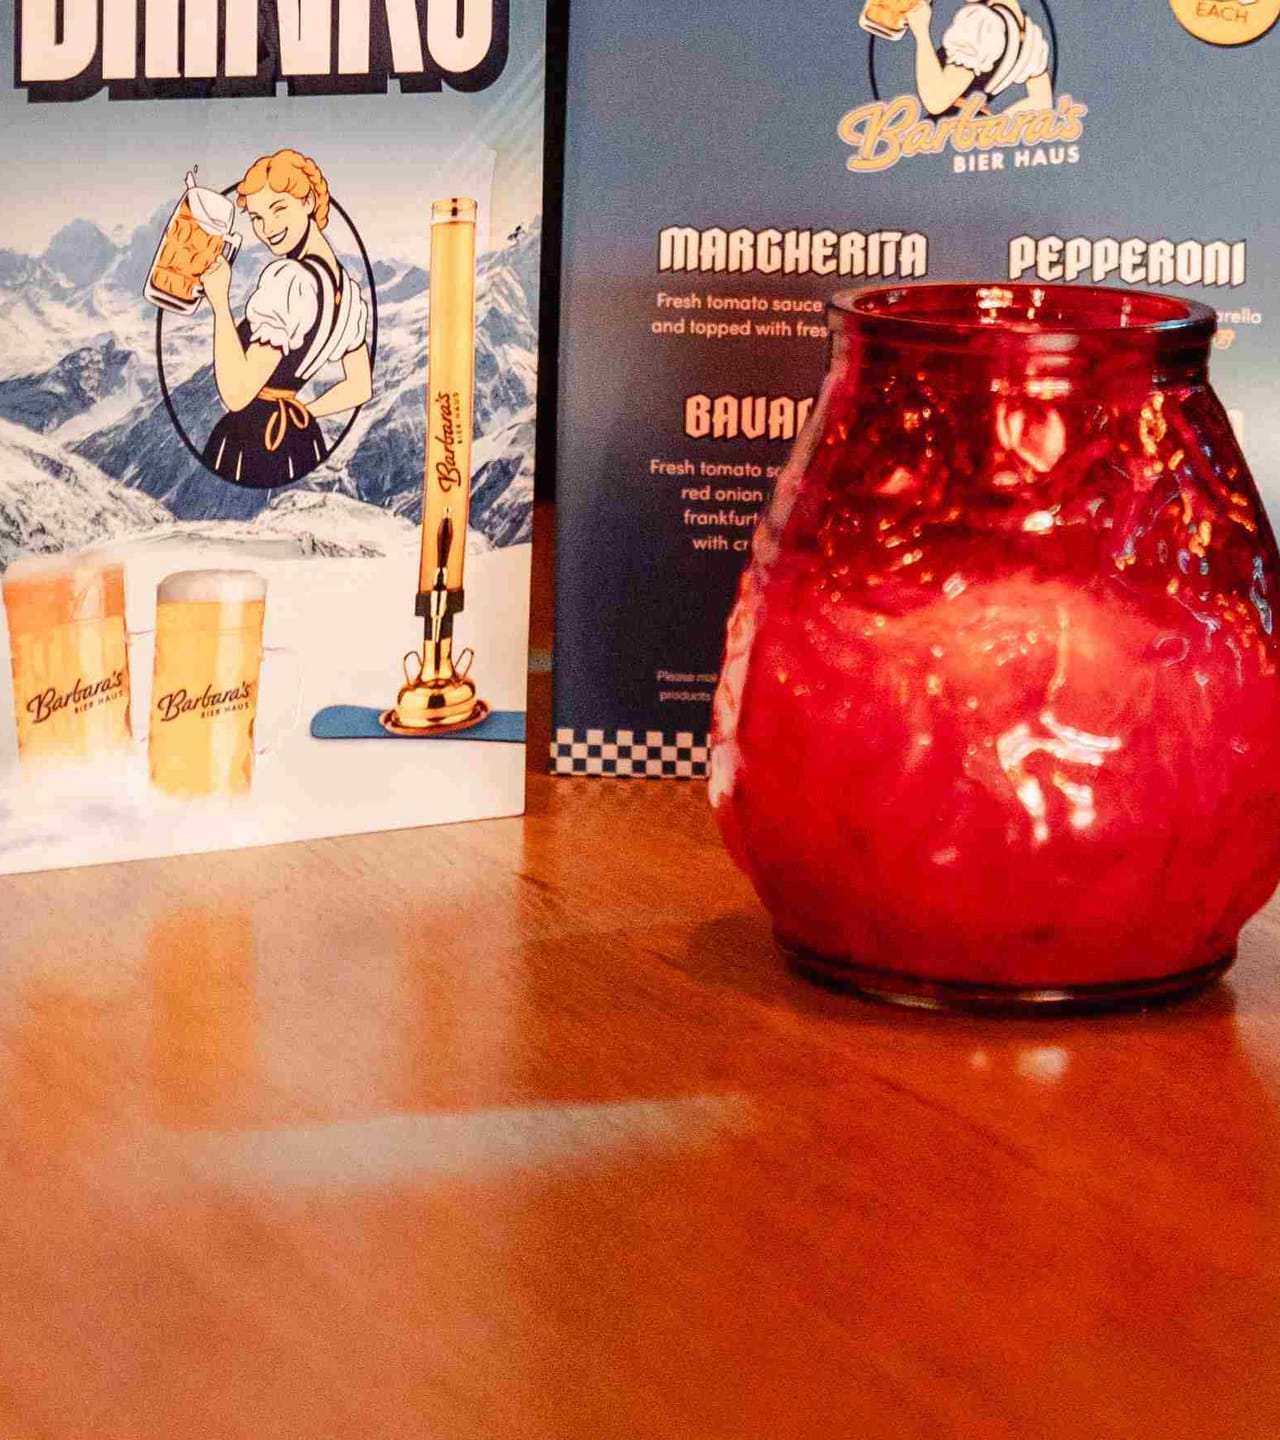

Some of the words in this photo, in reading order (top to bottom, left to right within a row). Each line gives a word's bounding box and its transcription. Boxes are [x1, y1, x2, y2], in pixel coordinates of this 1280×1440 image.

[1196, 1, 1249, 23] EACH
[837, 91, 1088, 172] Barbara's
[952, 154, 1004, 173] BIER
[1014, 146, 1081, 167] HAUS
[657, 224, 929, 279] MARGHERITA
[1007, 233, 1247, 288] PEPPERONI
[656, 291, 702, 310] Fresh
[707, 293, 769, 311] tomato
[772, 297, 824, 313] sauce
[651, 319, 685, 334] and
[690, 320, 751, 339] topped
[756, 320, 792, 336] with
[796, 321, 829, 338] fres
[650, 458, 695, 477] Fresh
[700, 460, 762, 479] tomato
[681, 485, 711, 501] red
[715, 486, 763, 502] onion
[692, 535, 728, 551] with
[26, 671, 123, 723] Barbara's
[157, 681, 252, 723] Barbara's
